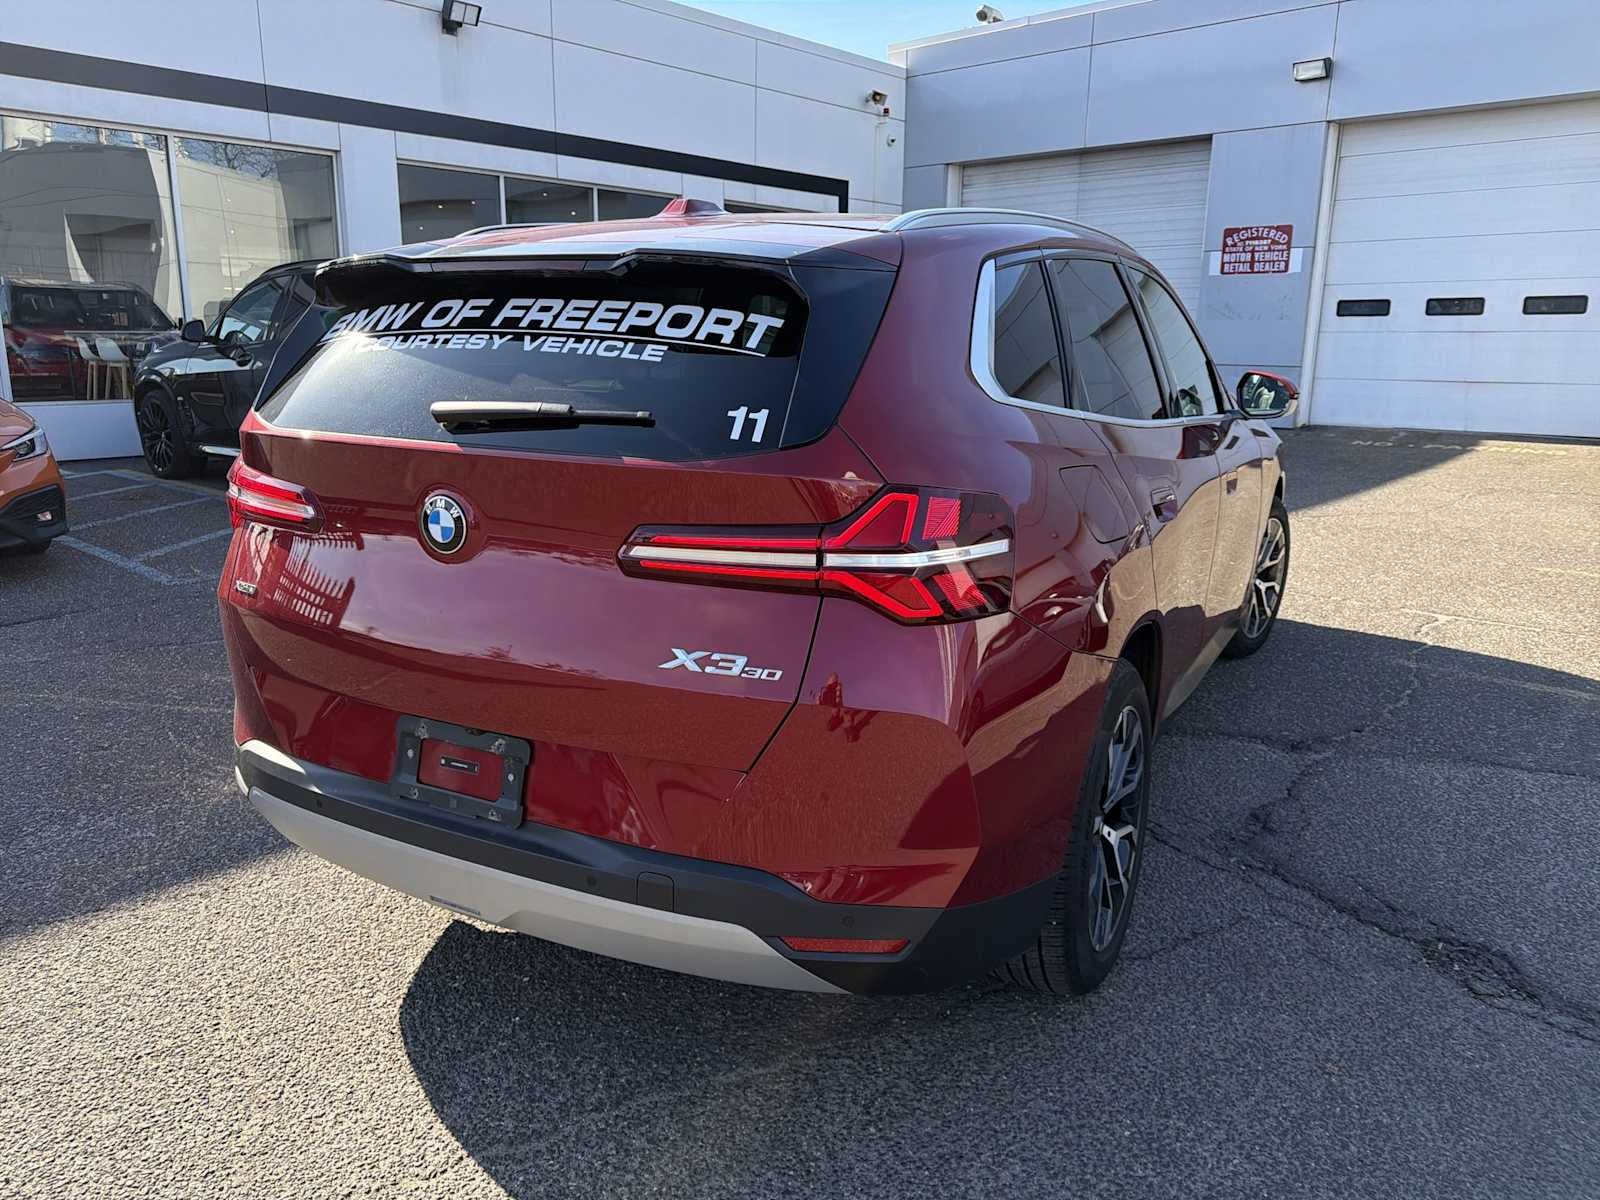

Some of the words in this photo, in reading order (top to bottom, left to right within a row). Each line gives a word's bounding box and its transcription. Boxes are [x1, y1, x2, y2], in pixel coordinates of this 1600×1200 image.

[1225, 227, 1289, 246] REGISTERED
[1223, 252, 1252, 263] MOTOR
[1254, 250, 1289, 261] VEHICLE
[1223, 262, 1252, 273] RETAIL
[1254, 261, 1286, 272] DEALER
[320, 301, 425, 342] BMW
[421, 298, 494, 329] OF
[491, 298, 784, 349] FREEPORT
[522, 335, 668, 362] VEHICLE
[727, 406, 769, 442] 11
[425, 498, 461, 518] BMW
